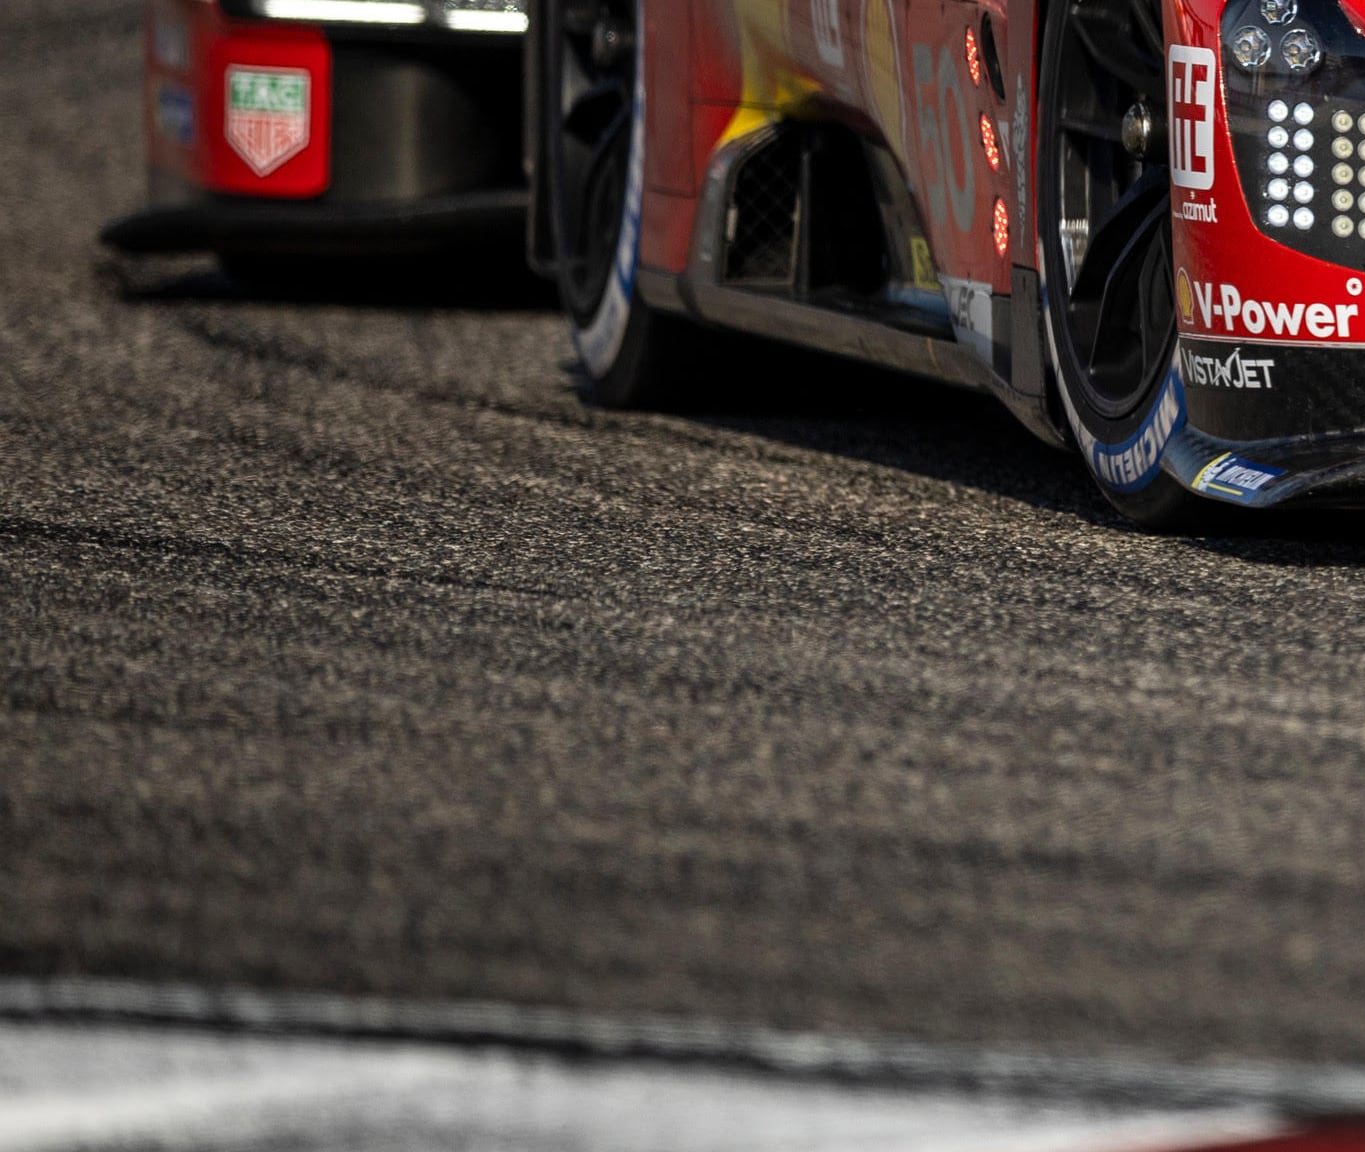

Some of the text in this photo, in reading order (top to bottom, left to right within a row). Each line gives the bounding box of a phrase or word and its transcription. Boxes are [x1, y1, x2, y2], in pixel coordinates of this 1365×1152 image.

[911, 42, 976, 234] 50
[1181, 197, 1219, 224] azimut
[1193, 280, 1360, 339] V-Power
[1097, 376, 1180, 485] MICHELIN
